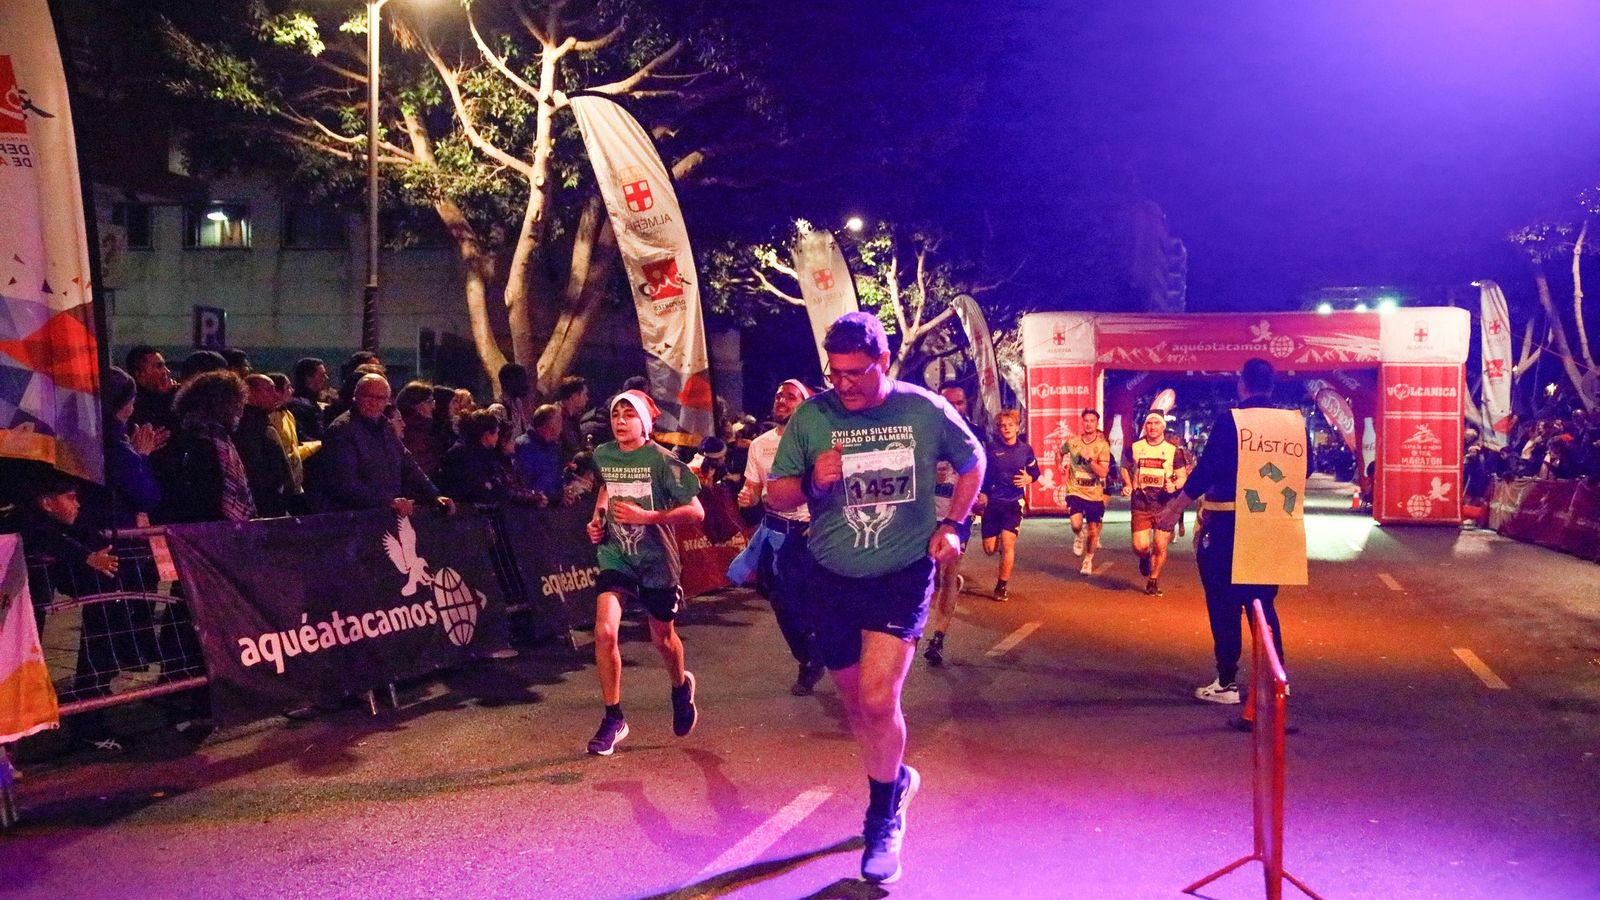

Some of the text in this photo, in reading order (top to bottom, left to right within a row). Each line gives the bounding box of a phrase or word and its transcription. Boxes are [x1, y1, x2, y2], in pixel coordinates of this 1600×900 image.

[869, 426, 913, 435] SILVESTRE
[850, 476, 909, 499] 1457
[237, 600, 438, 675] aquéatacamos
